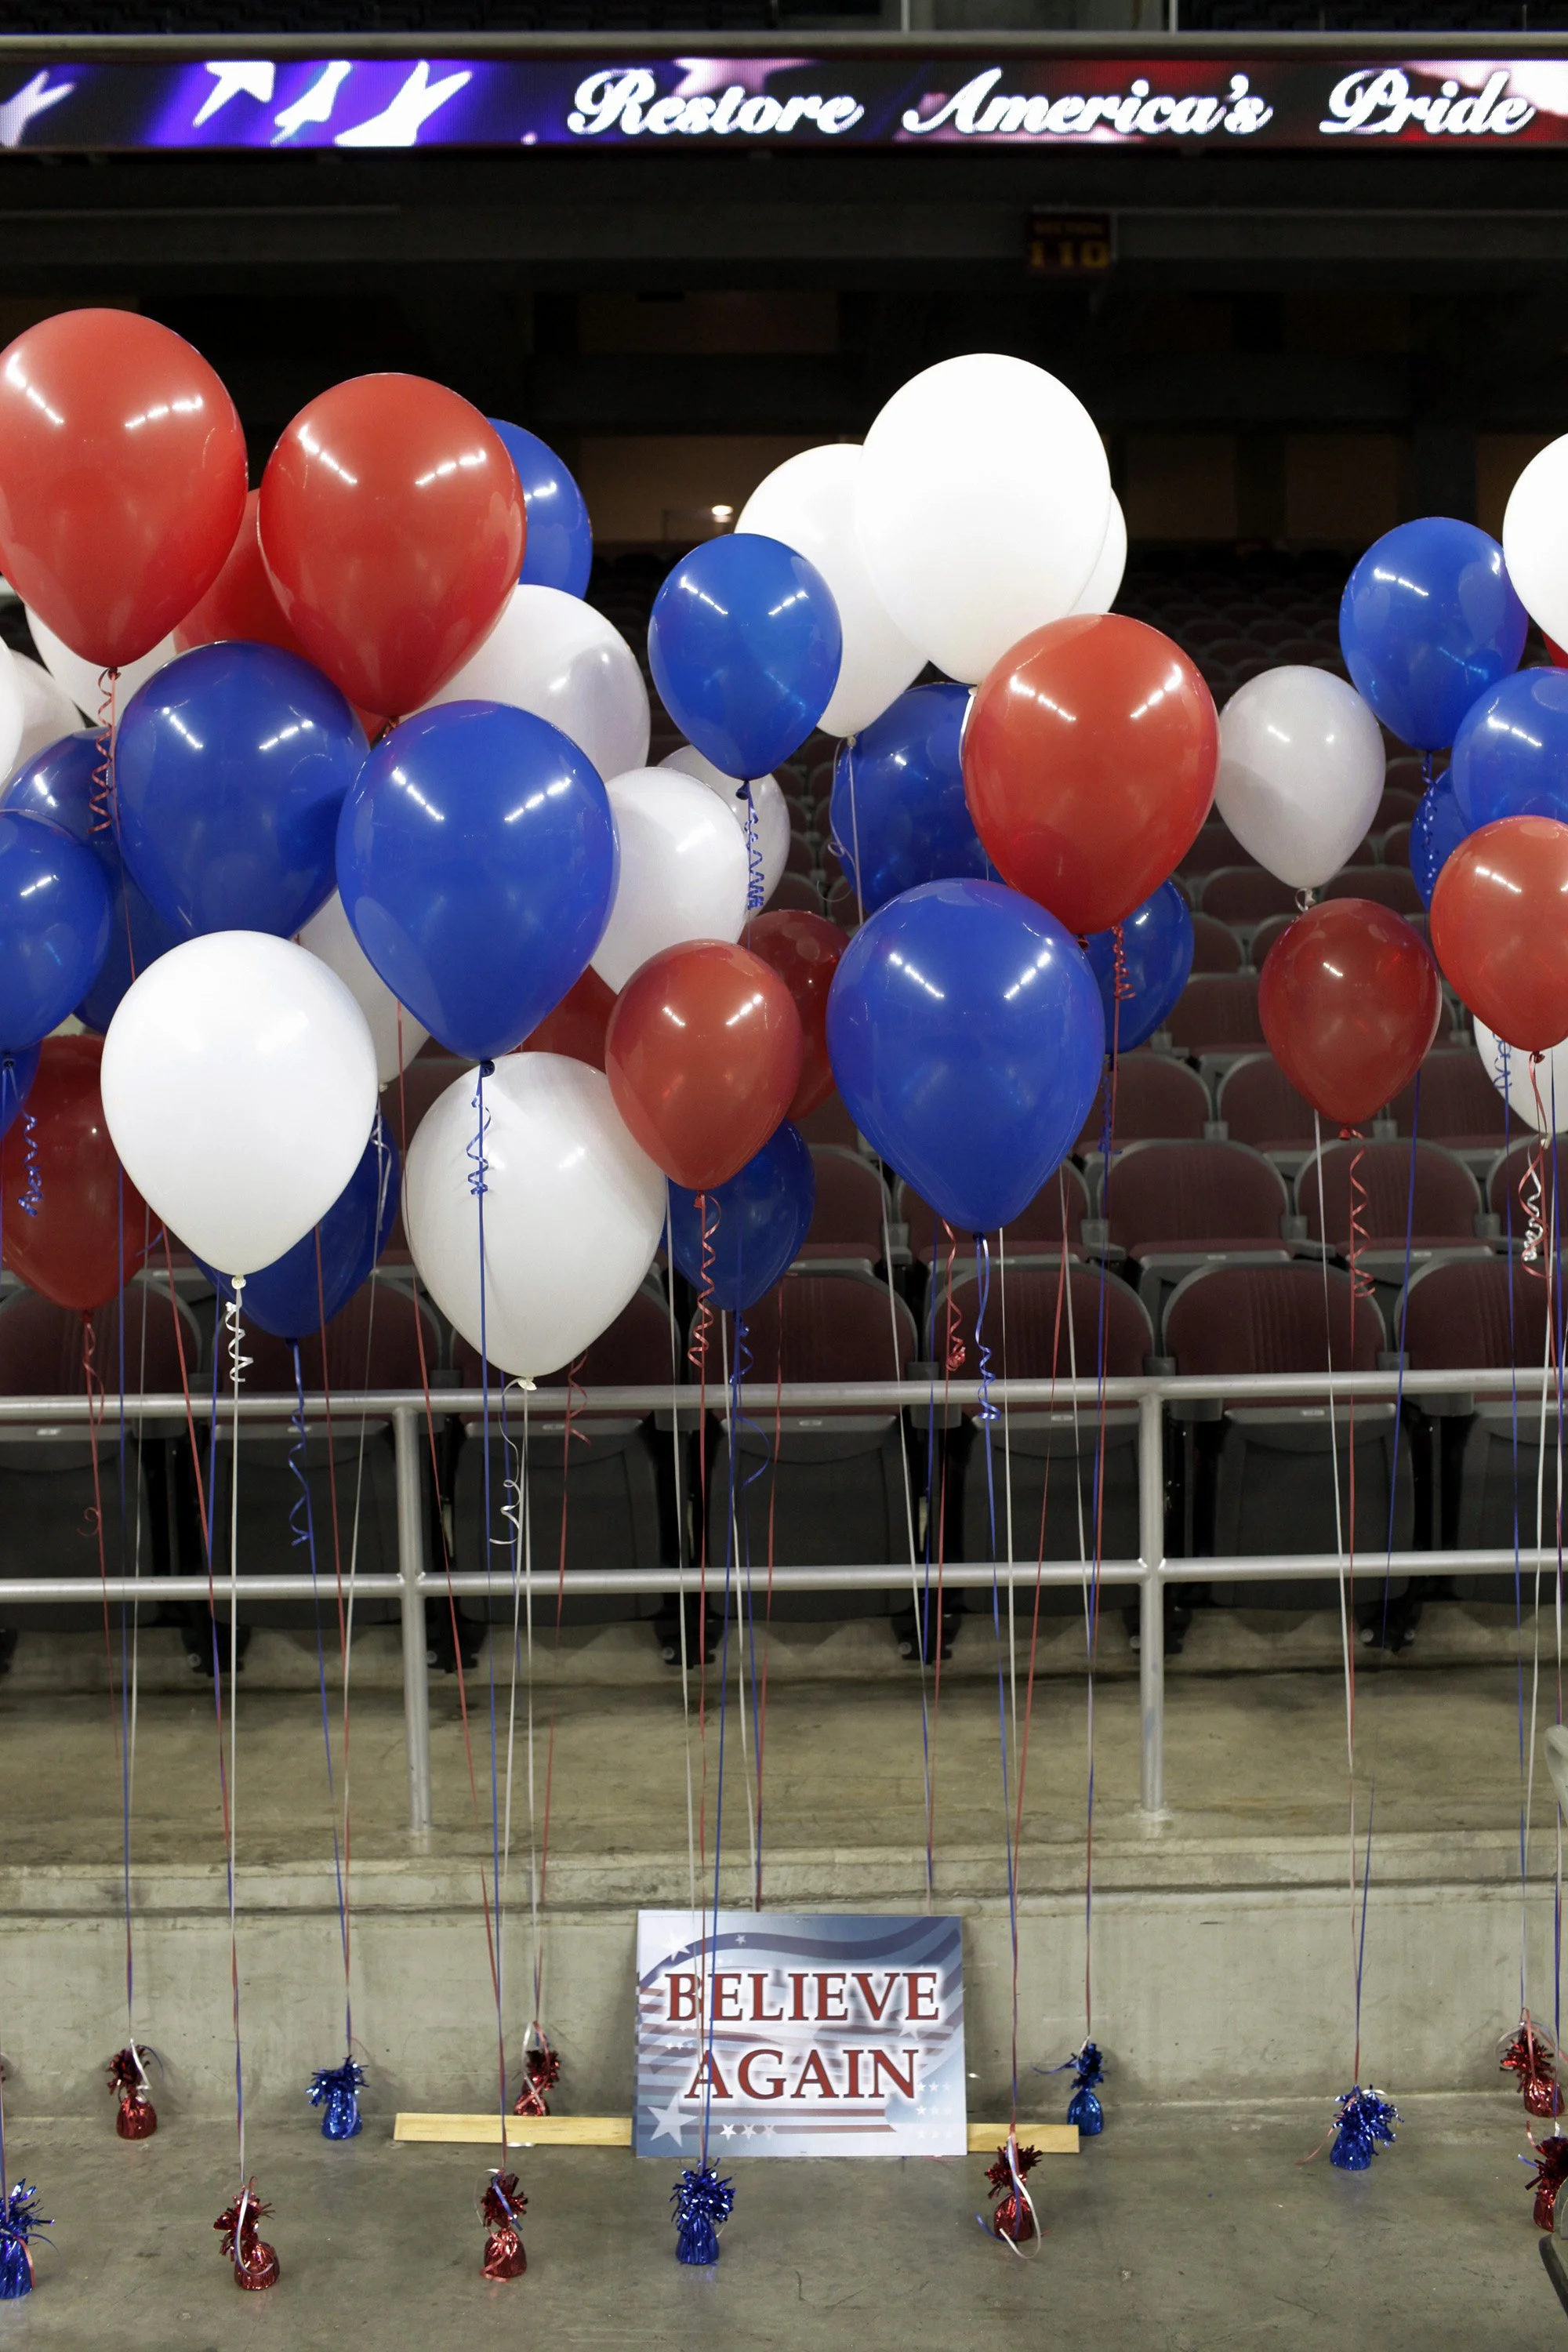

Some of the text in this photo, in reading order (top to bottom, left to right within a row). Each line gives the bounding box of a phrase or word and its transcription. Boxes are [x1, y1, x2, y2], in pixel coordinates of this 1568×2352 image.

[567, 67, 1537, 134] Restore America's Pride
[1029, 241, 1110, 269] 110
[664, 1973, 940, 2021] BELIEVE
[684, 2049, 919, 2100] AGAIN
